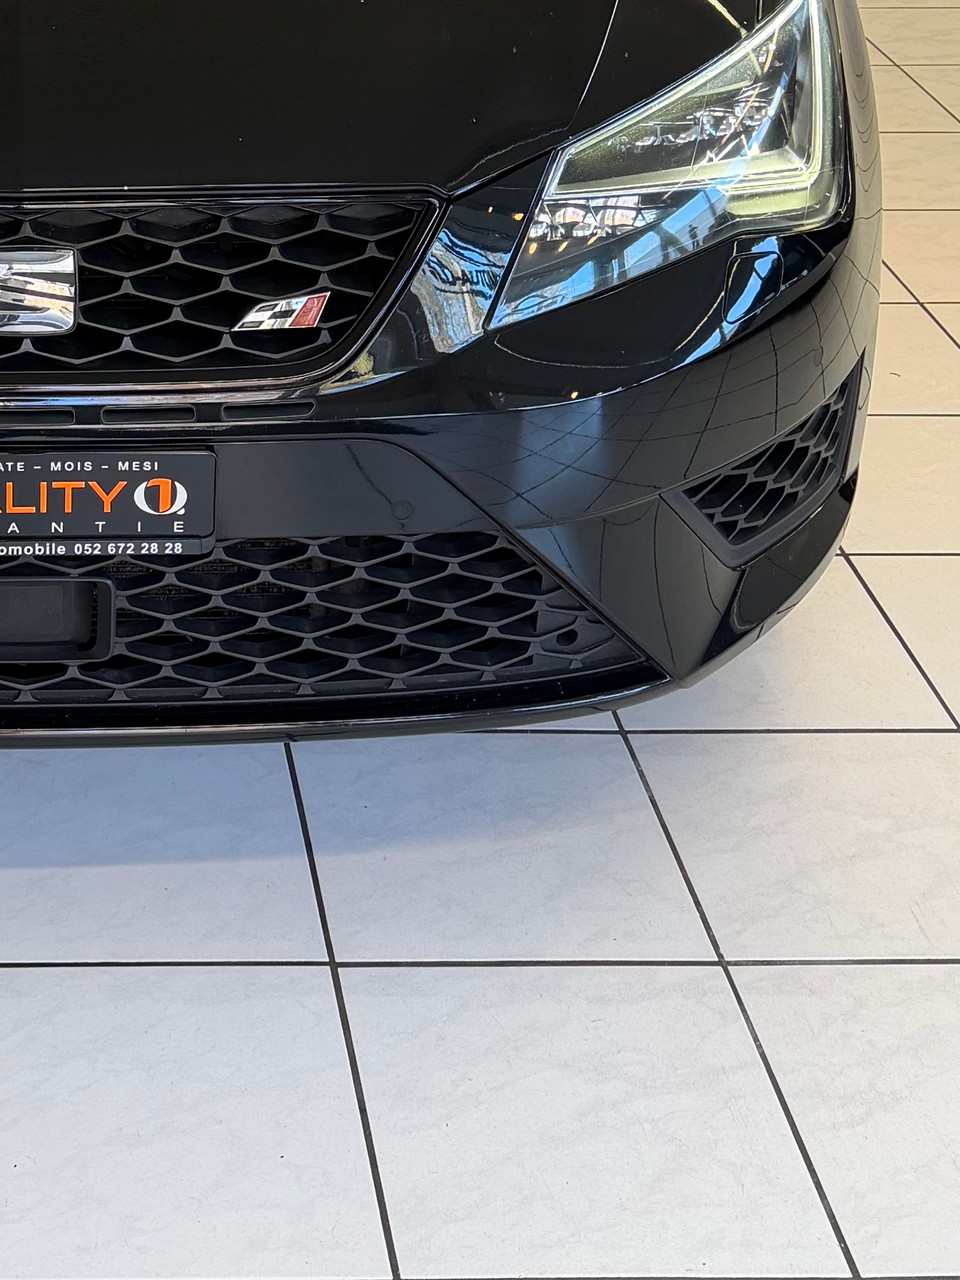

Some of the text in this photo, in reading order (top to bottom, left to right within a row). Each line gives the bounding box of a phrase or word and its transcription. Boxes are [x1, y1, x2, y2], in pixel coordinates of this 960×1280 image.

[50, 461, 93, 472] MOIS
[117, 460, 158, 471] MESI
[74, 542, 102, 555] 052
[107, 542, 135, 555] 672
[140, 542, 159, 555] 28
[164, 542, 183, 554] 28
